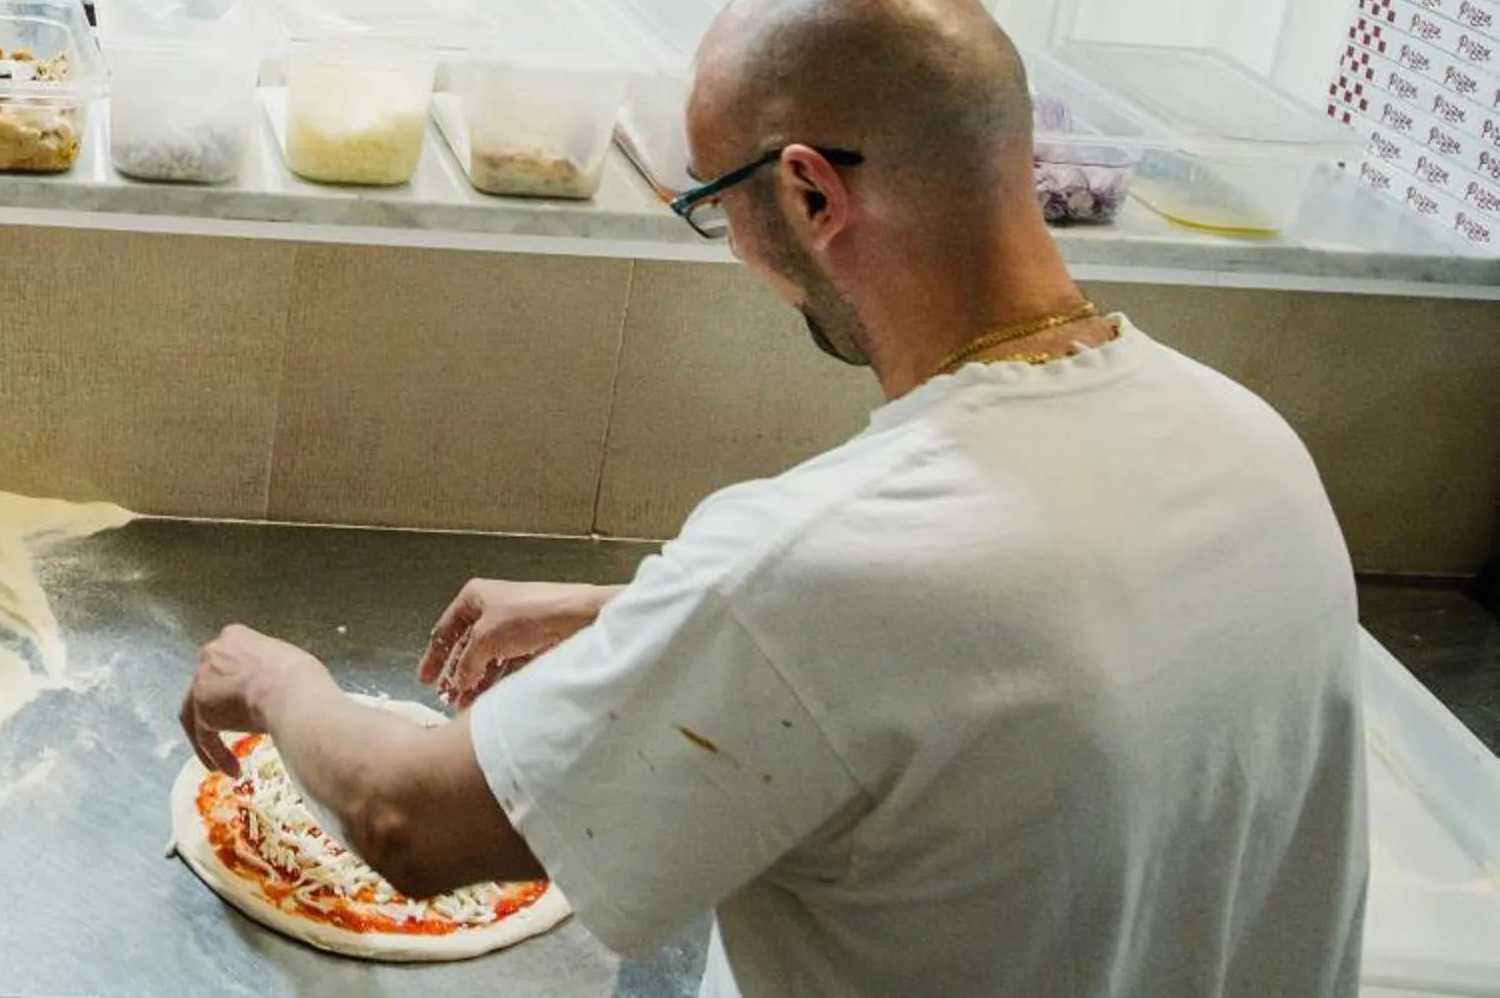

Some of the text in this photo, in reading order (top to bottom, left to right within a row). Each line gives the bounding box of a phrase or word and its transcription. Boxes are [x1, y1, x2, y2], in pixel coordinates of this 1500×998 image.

[1410, 13, 1492, 61] Pizza Pizza
[1457, 0, 1492, 27] Pizza
[1399, 44, 1477, 92] Pizza Pizza
[1388, 73, 1417, 98] Pizza
[1431, 95, 1466, 122] Pizza
[1381, 103, 1412, 131] Pizza
[1428, 126, 1461, 154] Pizza
[1416, 156, 1449, 184] Pizza
[1406, 186, 1438, 215] Pizza
[1454, 211, 1490, 243] Pizza
